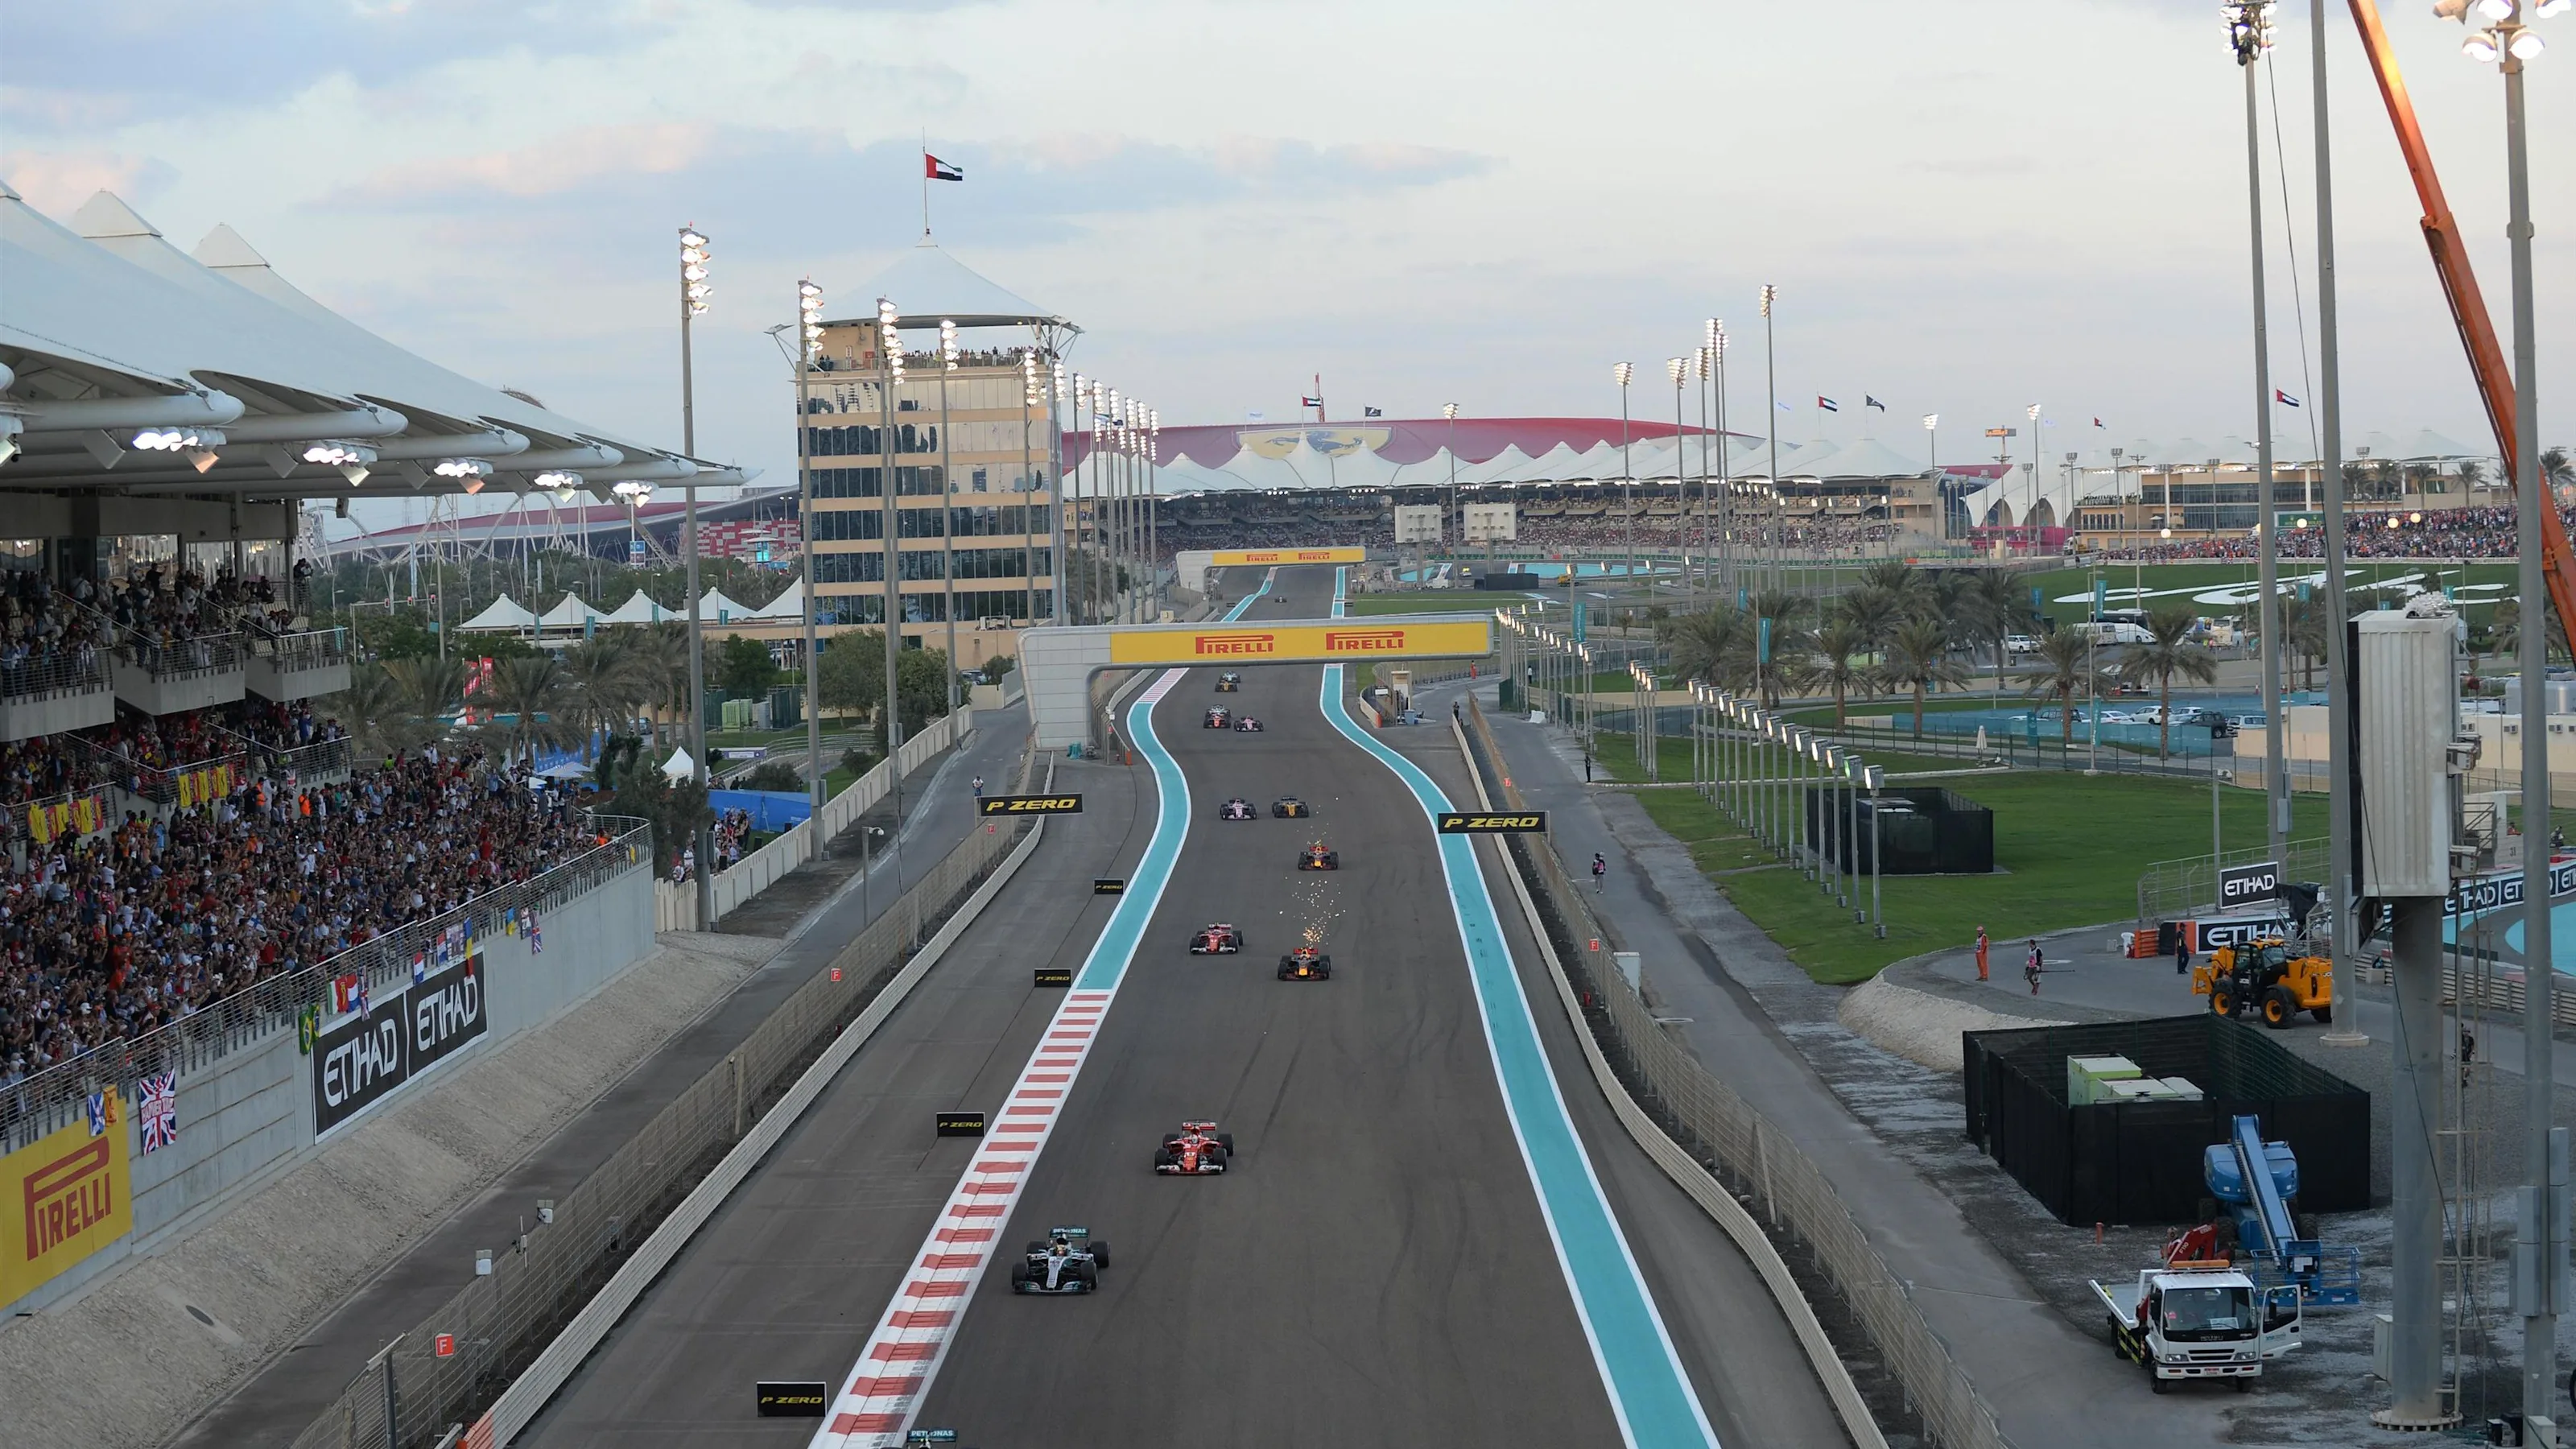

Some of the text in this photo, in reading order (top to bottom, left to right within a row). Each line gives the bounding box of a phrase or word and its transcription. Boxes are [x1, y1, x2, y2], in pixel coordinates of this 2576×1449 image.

[1247, 551, 1330, 562] PIRELLI PIRELLI
[1195, 631, 1405, 654] PIRELLI PIRELLI
[986, 799, 1076, 811] P ZERO
[1444, 817, 1539, 828] P ZERO
[2224, 873, 2275, 897] ETIHAD
[1591, 941, 1597, 950] F
[833, 971, 839, 979] F
[416, 975, 478, 1052] ETIHAD
[324, 1018, 398, 1108] ETIHAD
[23, 1136, 111, 1261] PIRELLI
[439, 1339, 448, 1352] F
